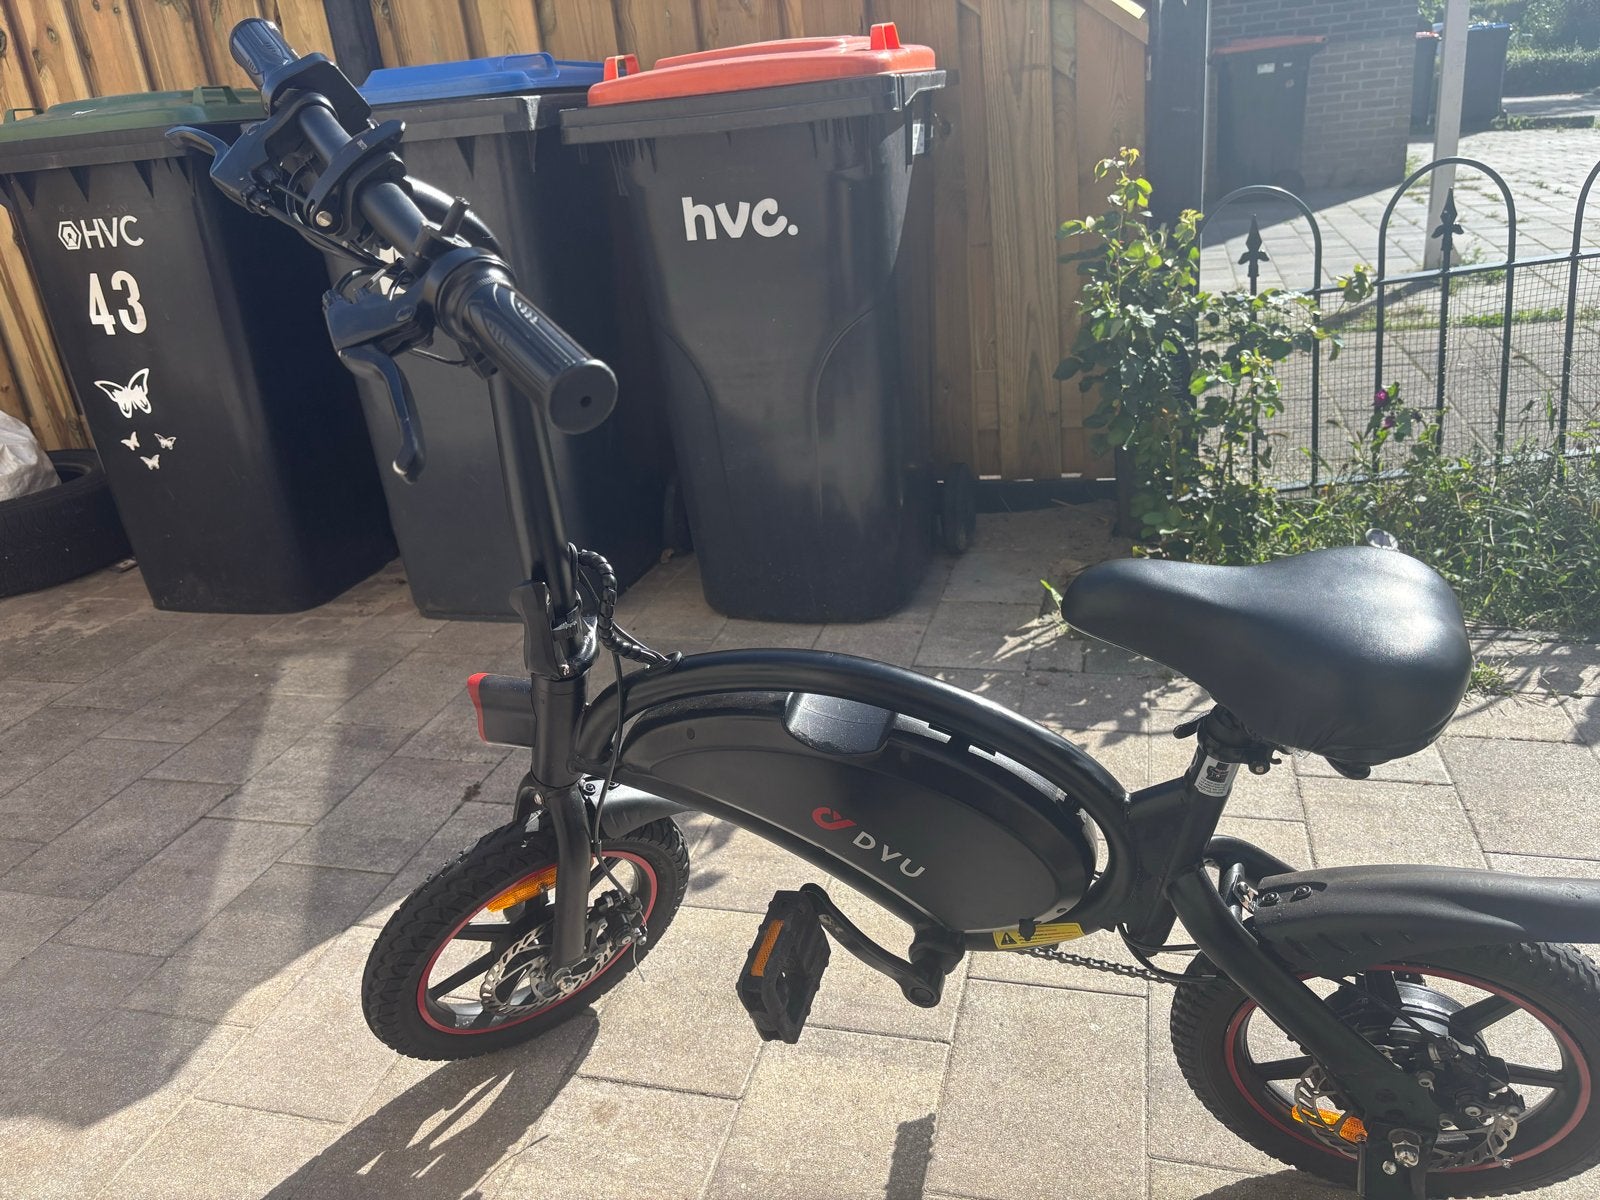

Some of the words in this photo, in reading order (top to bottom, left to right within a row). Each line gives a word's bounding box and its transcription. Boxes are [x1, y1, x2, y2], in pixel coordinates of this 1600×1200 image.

[80, 215, 145, 249] HVC
[681, 196, 799, 241] hvc.
[89, 270, 147, 336] 43
